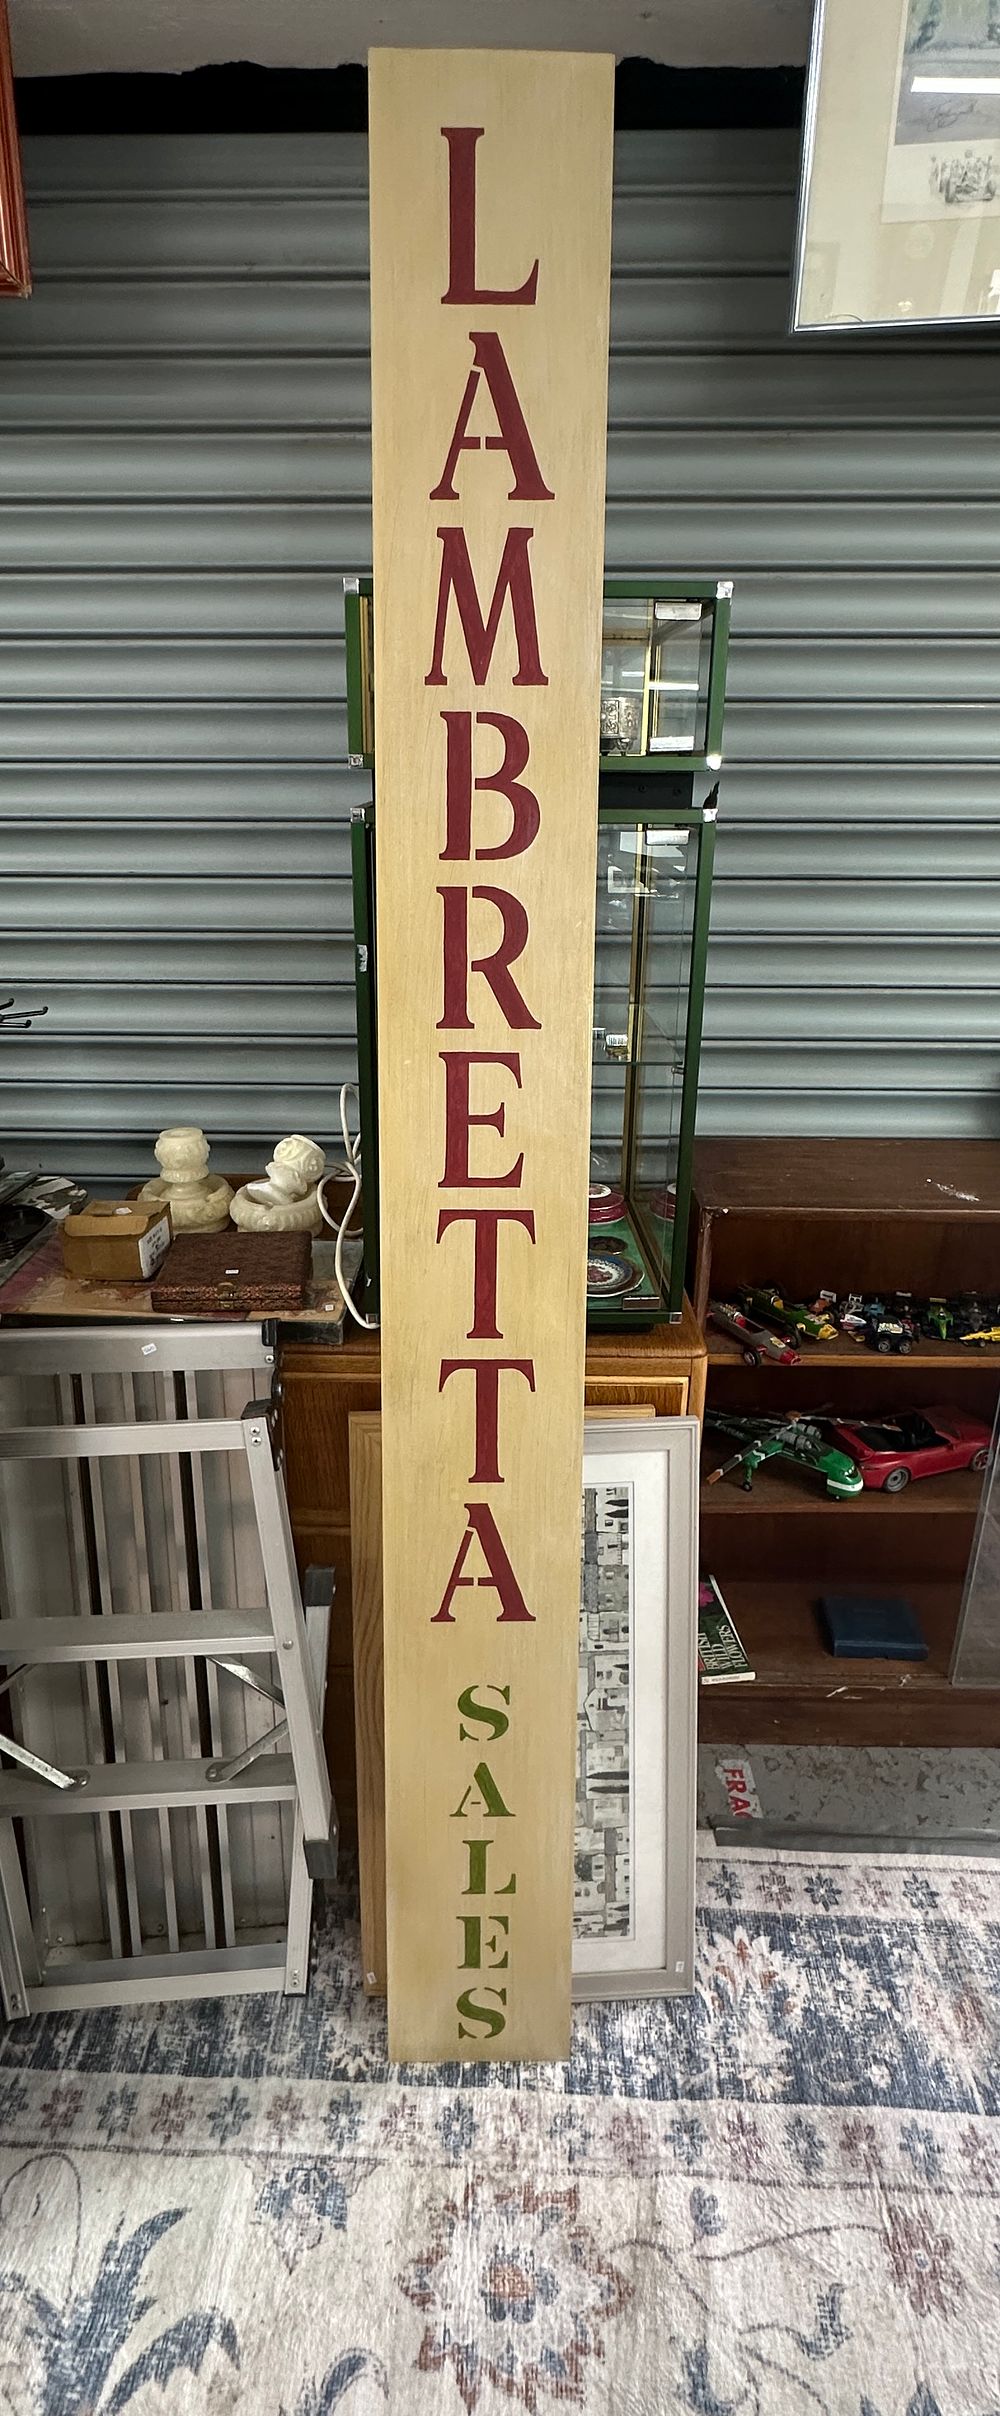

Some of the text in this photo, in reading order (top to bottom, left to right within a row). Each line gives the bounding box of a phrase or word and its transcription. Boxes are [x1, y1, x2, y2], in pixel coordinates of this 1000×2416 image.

[425, 127, 554, 1624] LAMBRETTA
[712, 1643, 734, 1670] WILD
[718, 1624, 748, 1668] FLOWERS
[449, 1684, 517, 2040] SALES
